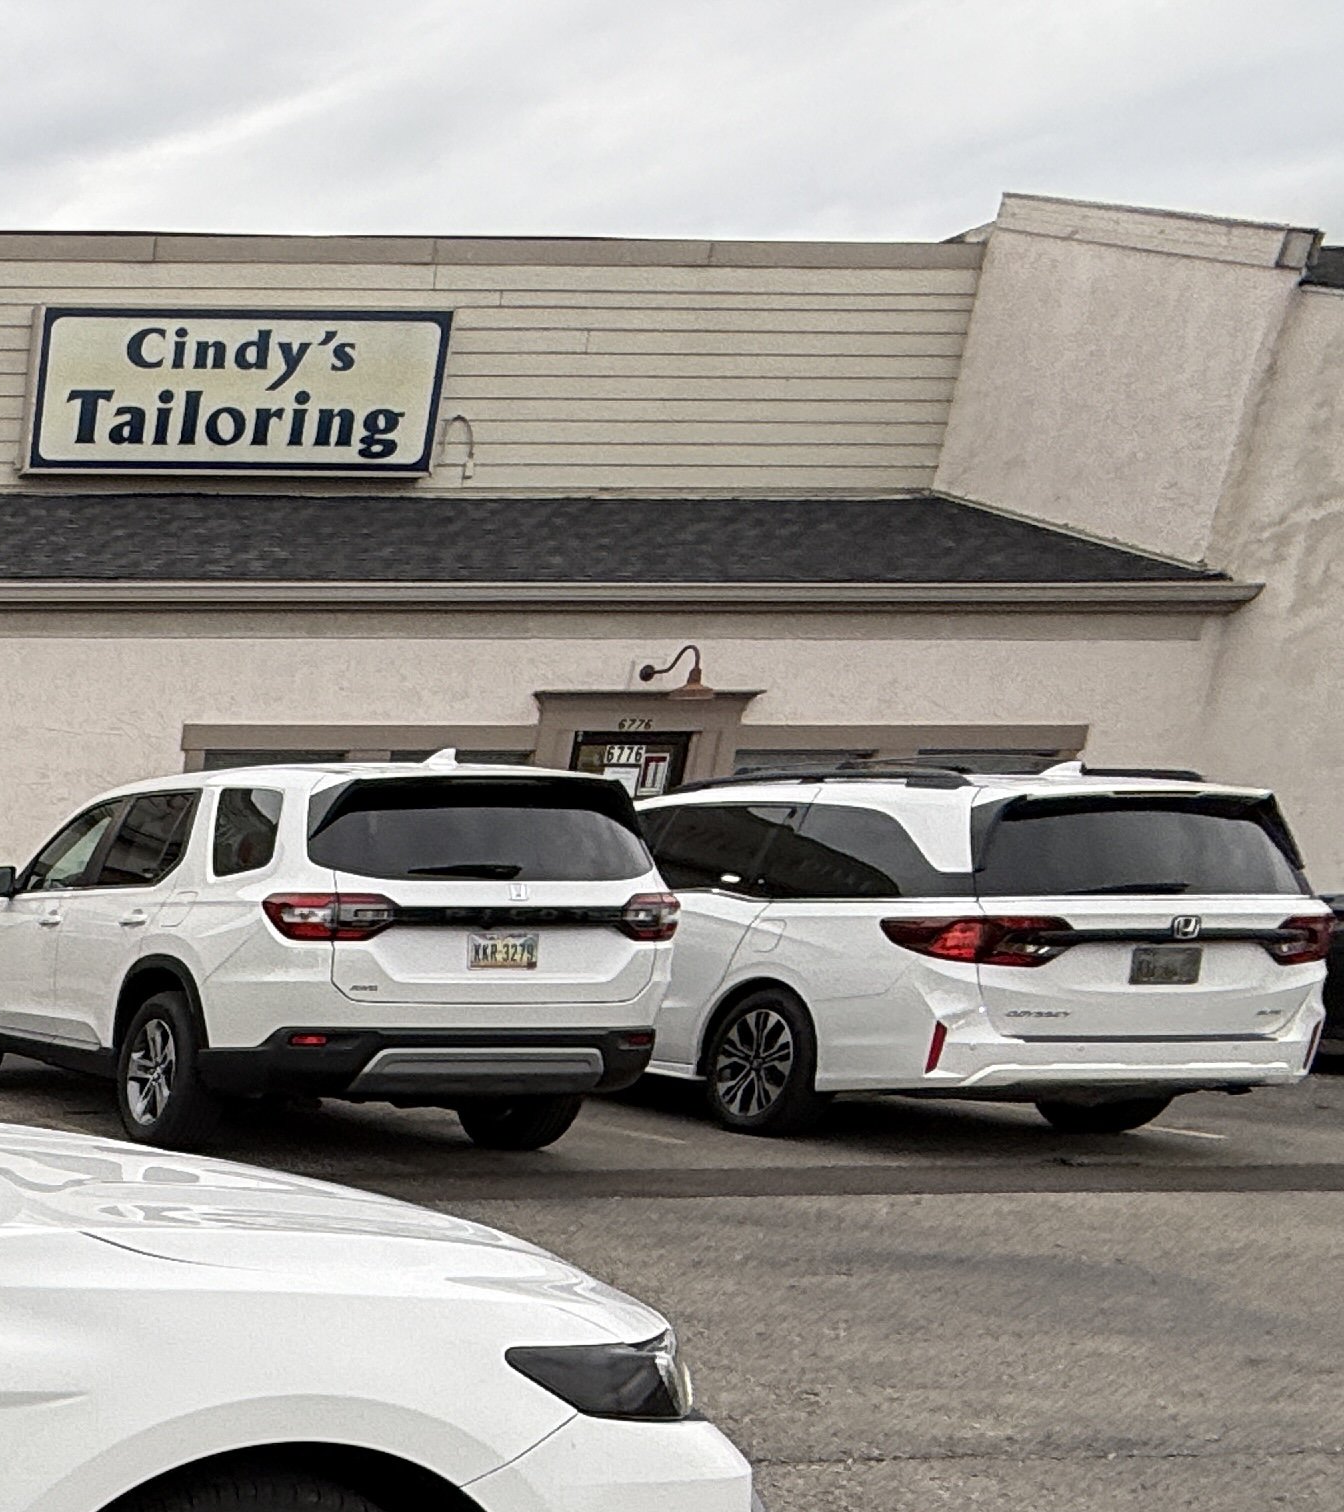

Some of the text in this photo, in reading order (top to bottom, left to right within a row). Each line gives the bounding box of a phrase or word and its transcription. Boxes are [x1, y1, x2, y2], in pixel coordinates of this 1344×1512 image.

[125, 327, 357, 392] Cindy's
[66, 389, 405, 460] Tailoring
[618, 718, 652, 730] 6776
[607, 746, 643, 763] 6776
